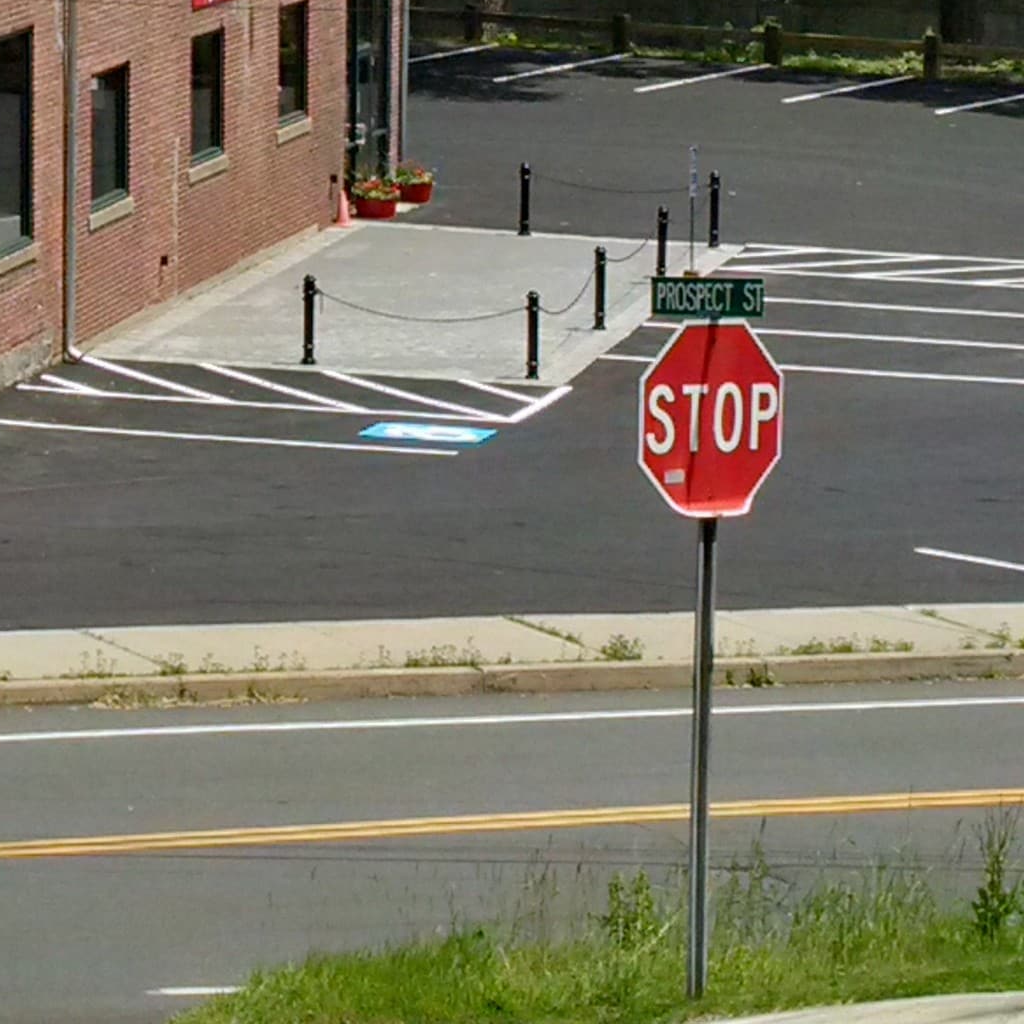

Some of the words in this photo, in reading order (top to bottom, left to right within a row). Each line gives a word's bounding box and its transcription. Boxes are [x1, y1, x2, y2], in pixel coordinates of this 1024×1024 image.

[657, 283, 733, 311] PROSPECT
[742, 284, 764, 312] ST
[646, 382, 778, 455] STOP
